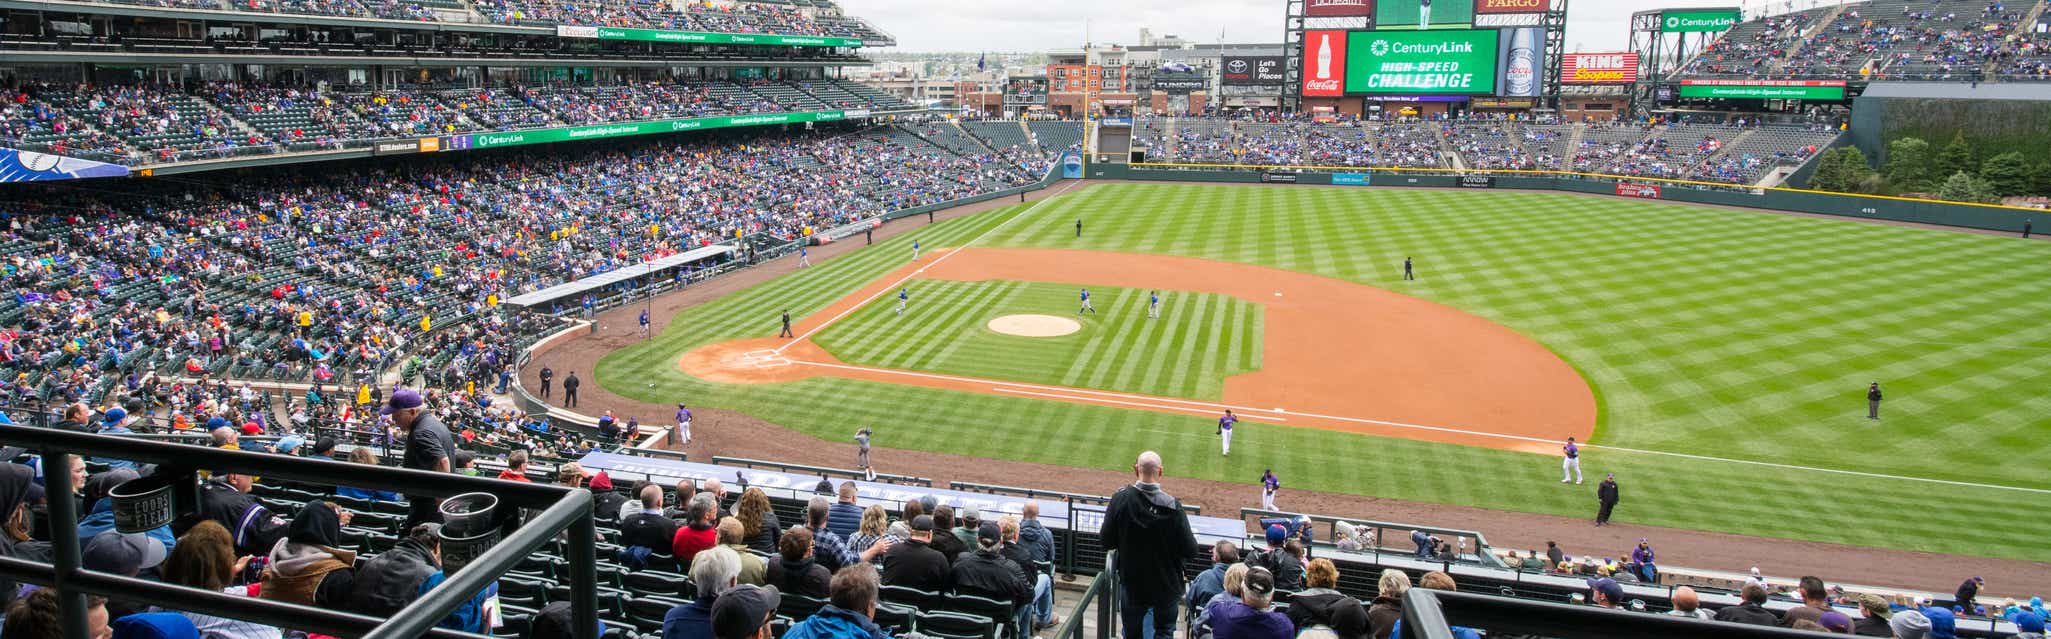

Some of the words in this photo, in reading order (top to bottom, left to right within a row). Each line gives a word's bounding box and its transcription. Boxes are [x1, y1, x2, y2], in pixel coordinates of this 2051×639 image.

[1486, 0, 1540, 8] FARGO
[1392, 41, 1472, 55] CenturyLink
[1381, 61, 1459, 72] HIGH-SPEED
[1576, 55, 1624, 68] KING
[1368, 73, 1472, 88] CHALLENGE
[1574, 67, 1624, 82] Soopers
[488, 135, 524, 144] CenturyLink
[134, 494, 169, 513] COORS
[135, 507, 169, 528] FIELD
